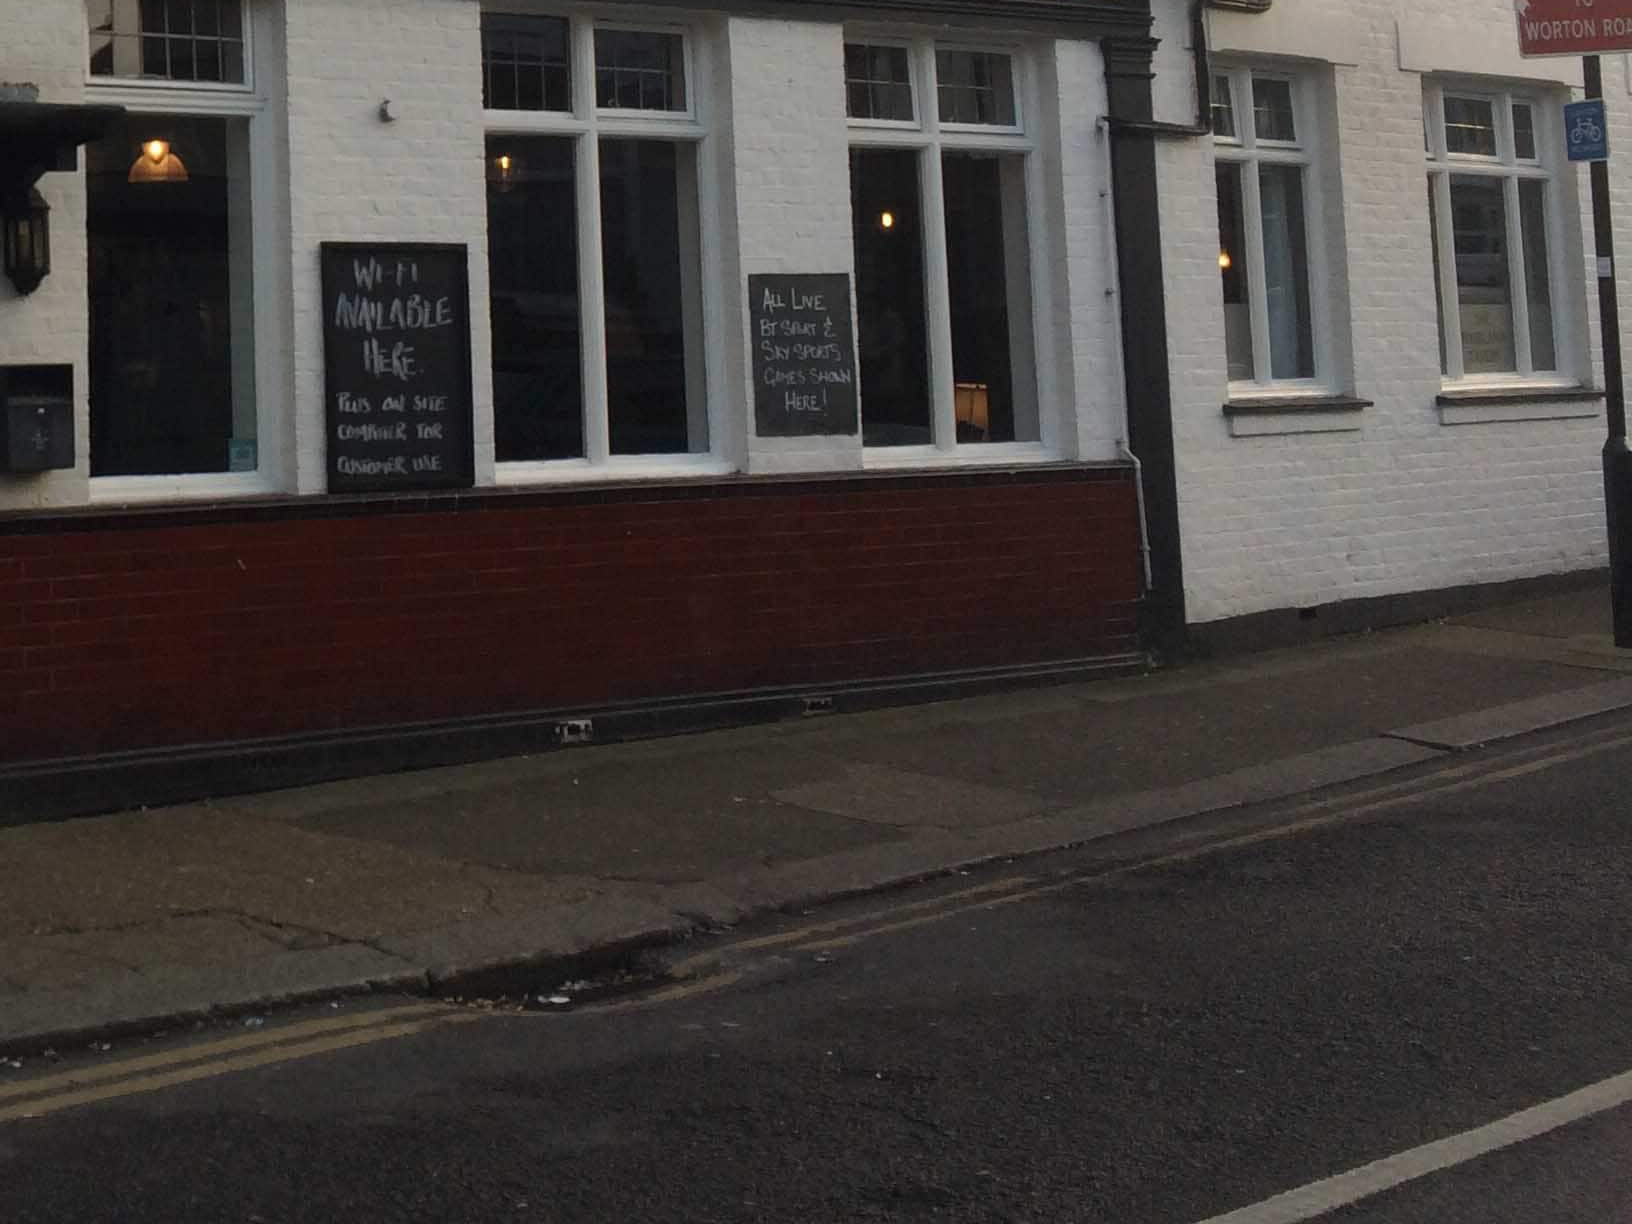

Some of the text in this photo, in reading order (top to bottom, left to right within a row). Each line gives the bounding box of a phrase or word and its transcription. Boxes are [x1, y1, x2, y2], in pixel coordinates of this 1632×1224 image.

[1525, 19, 1596, 40] WORTON
[335, 291, 454, 333] AVAILABLE
[763, 287, 827, 315] ALL LIVE
[759, 318, 778, 337] BT
[760, 339, 842, 362] SKY SPORTS
[763, 366, 852, 388] GAMES SHOWN
[335, 392, 449, 414] PLUS ON SITE
[336, 455, 443, 475] CUSTOMER USE
